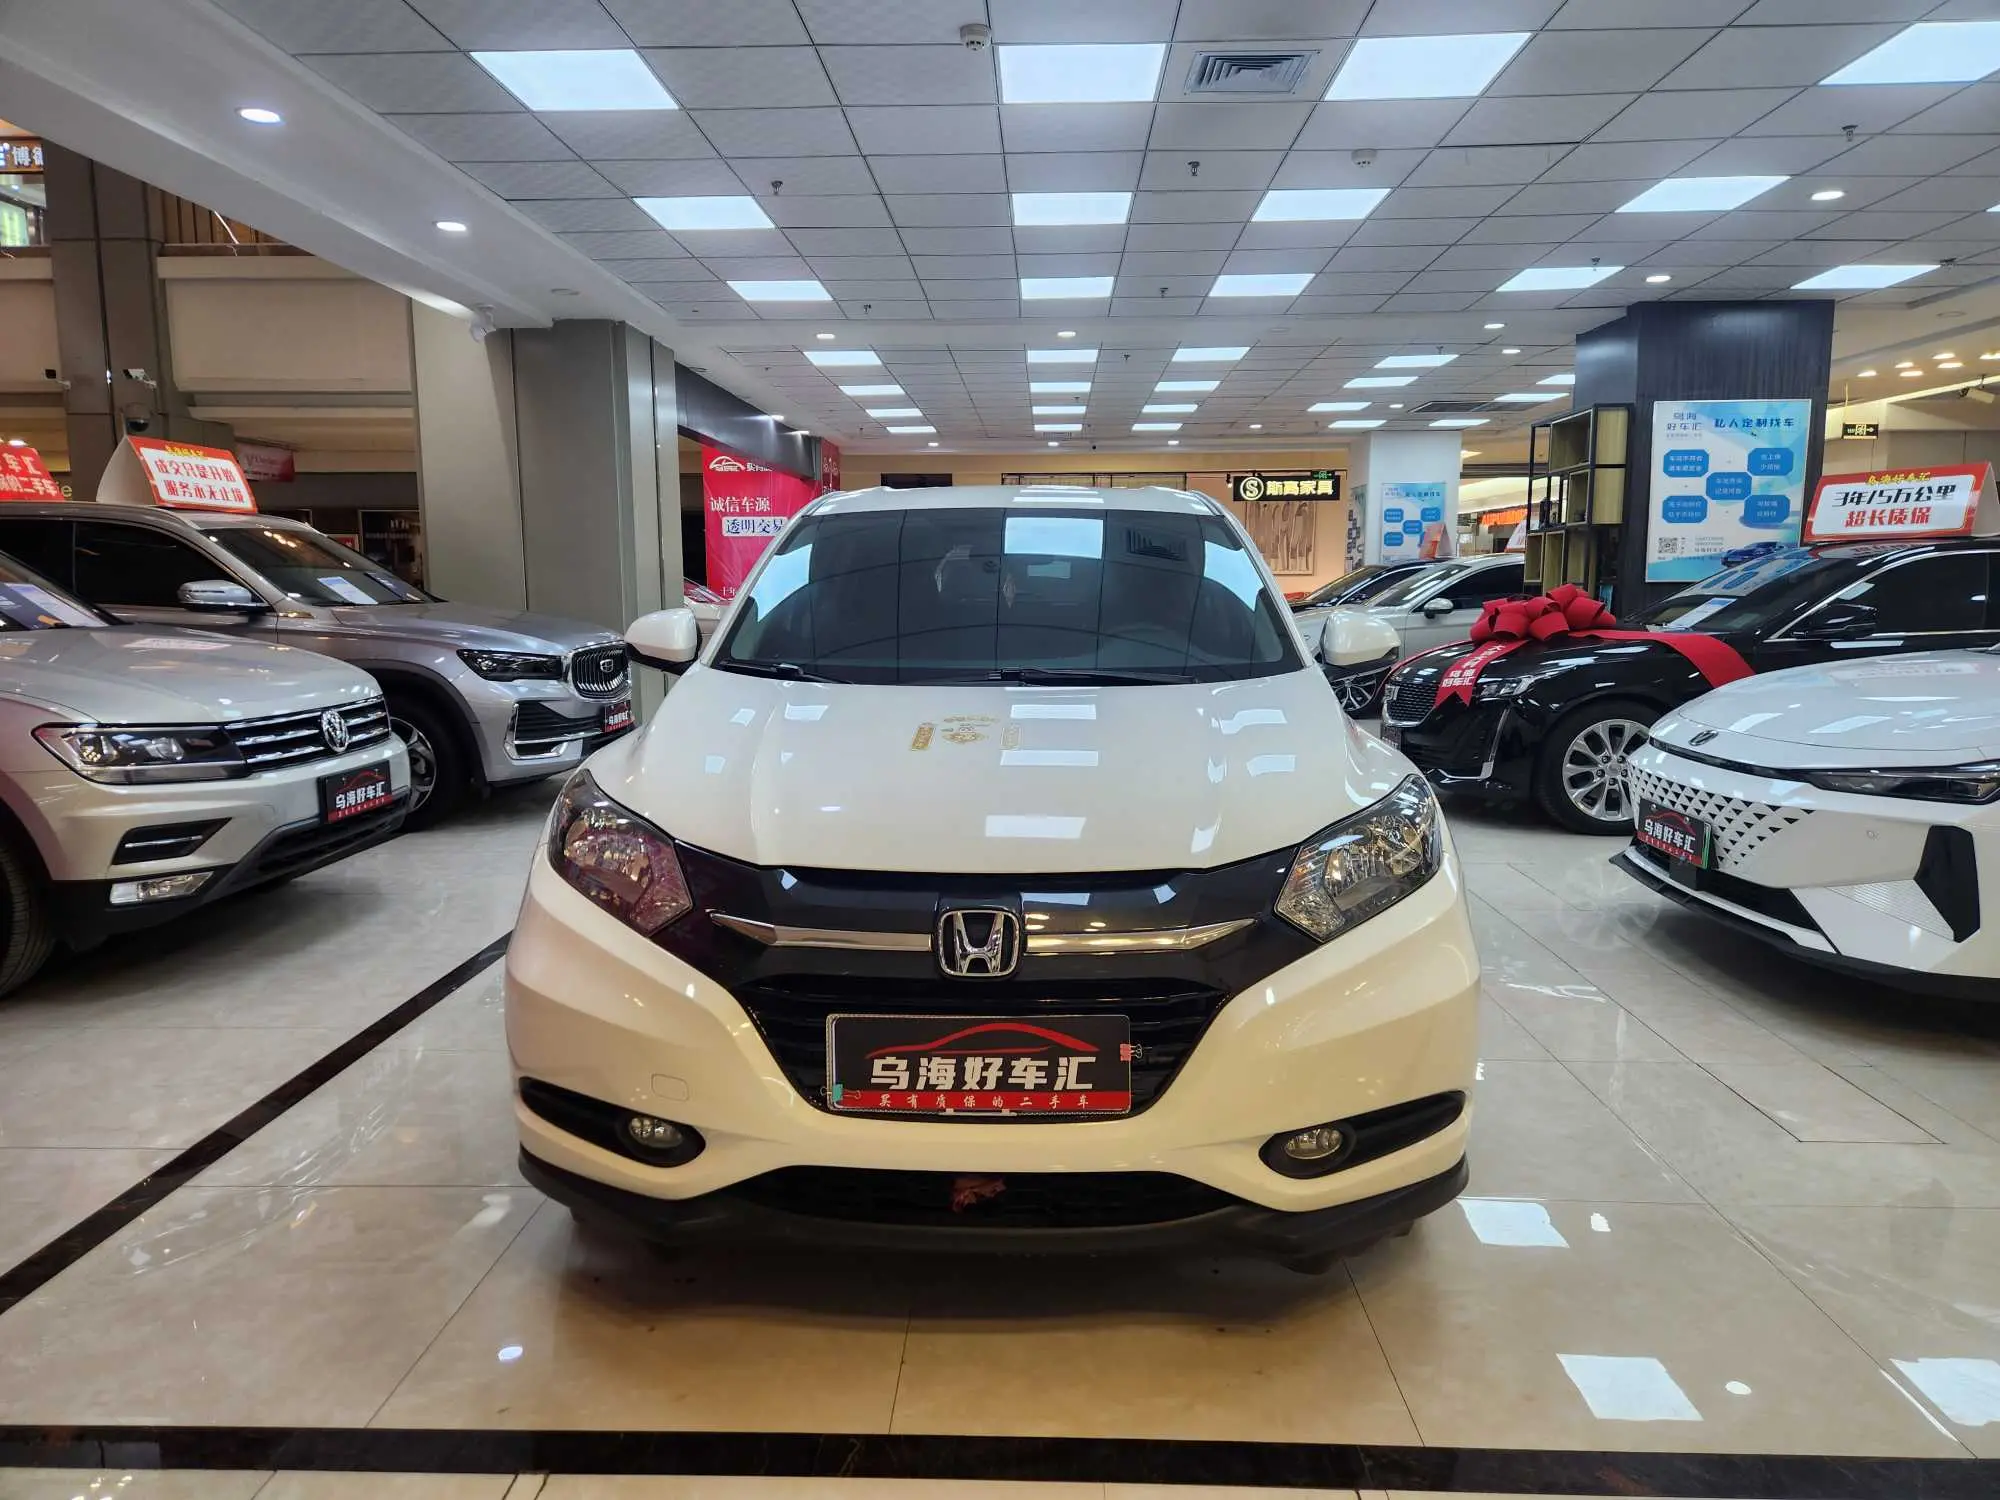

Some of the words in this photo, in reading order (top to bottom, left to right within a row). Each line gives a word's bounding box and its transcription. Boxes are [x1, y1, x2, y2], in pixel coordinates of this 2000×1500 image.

[710, 496, 771, 513] 诚信车源
[726, 518, 785, 535] 透明交易
[1845, 506, 1932, 528] 超长质保
[335, 781, 386, 810] 乌海好车汇
[1644, 818, 1696, 854] 乌海好车汇
[870, 1056, 1096, 1090] 乌海好车汇
[879, 1093, 1090, 1109] 买有质保的二手车
